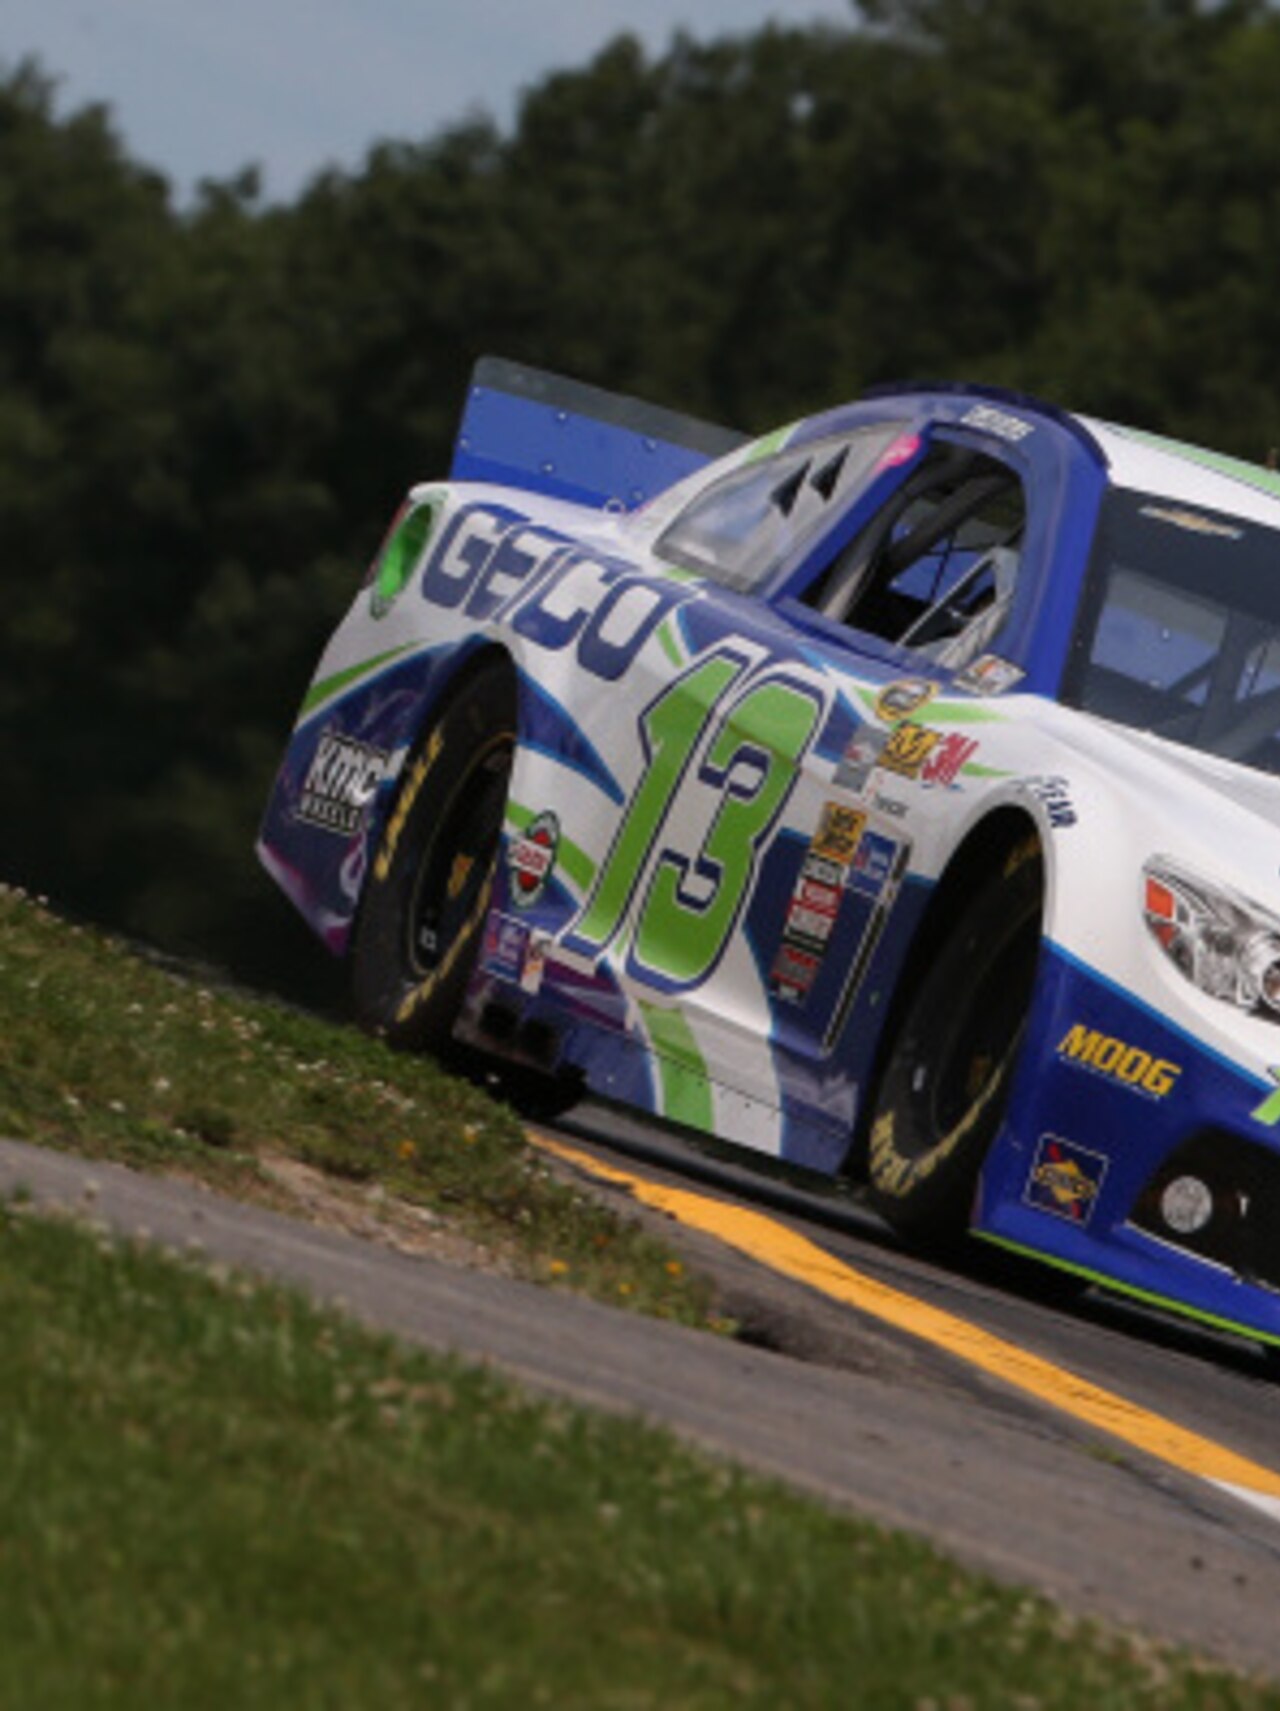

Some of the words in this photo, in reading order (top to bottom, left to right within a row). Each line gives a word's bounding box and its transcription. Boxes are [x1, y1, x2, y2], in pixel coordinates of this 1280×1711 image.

[421, 501, 680, 681] GEICO
[559, 644, 826, 995] 13
[1056, 1023, 1182, 1096] MOOG
